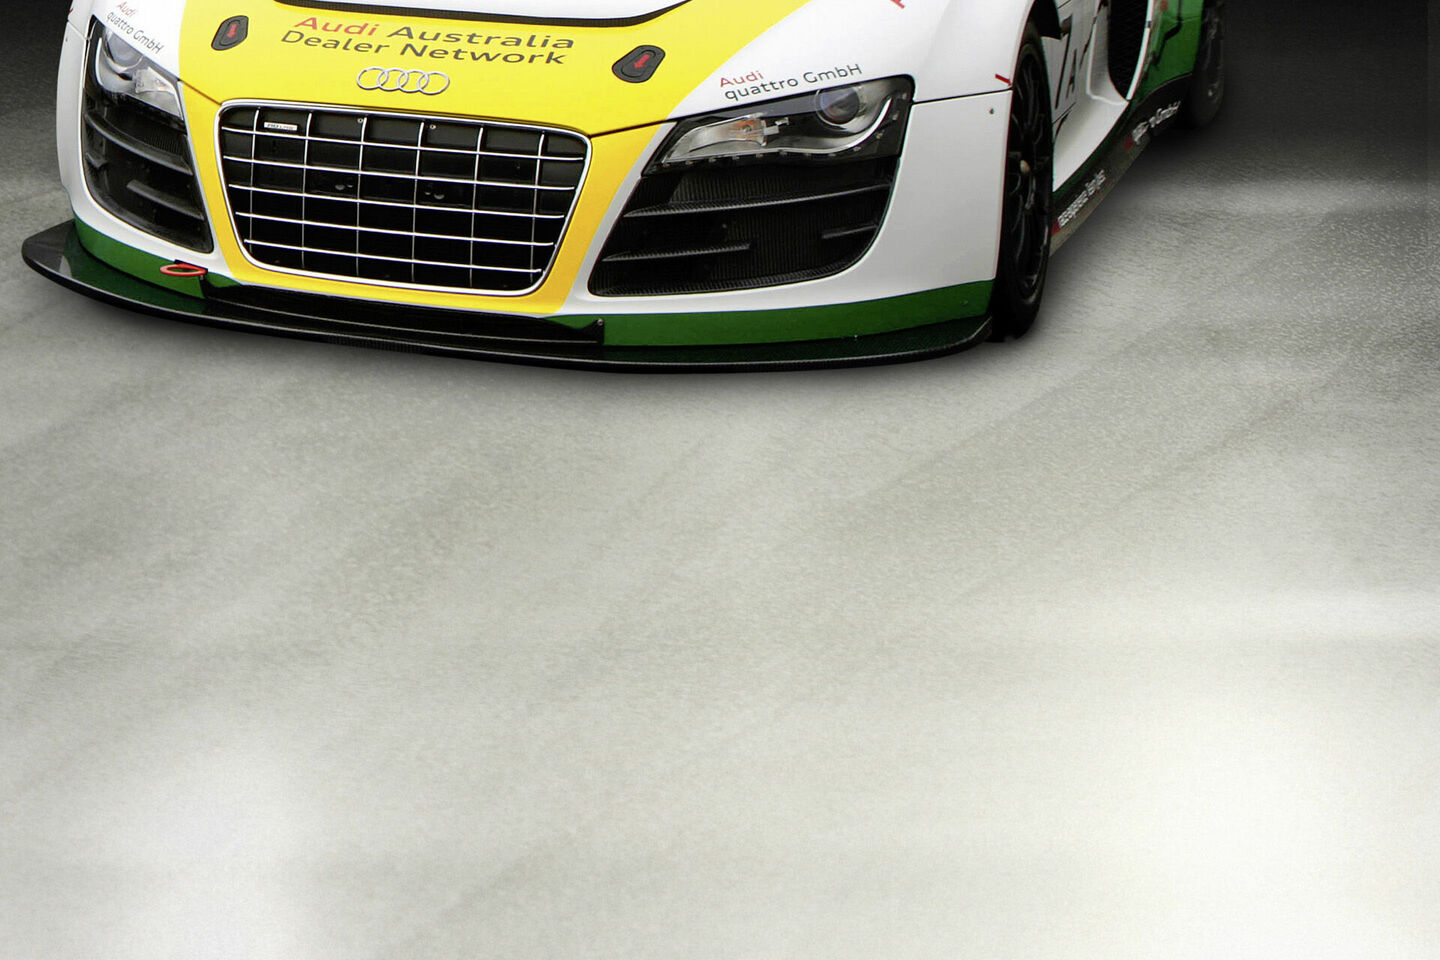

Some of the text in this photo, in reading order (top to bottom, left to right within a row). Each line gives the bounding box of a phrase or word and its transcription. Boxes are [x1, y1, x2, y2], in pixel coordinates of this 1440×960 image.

[116, 1, 138, 18] Audi
[106, 11, 165, 55] quattro GmbH
[281, 30, 567, 65] Dealer Network
[293, 16, 575, 49] Audi Australia
[720, 70, 764, 88] Audi
[725, 63, 863, 101] quattro GmbH
